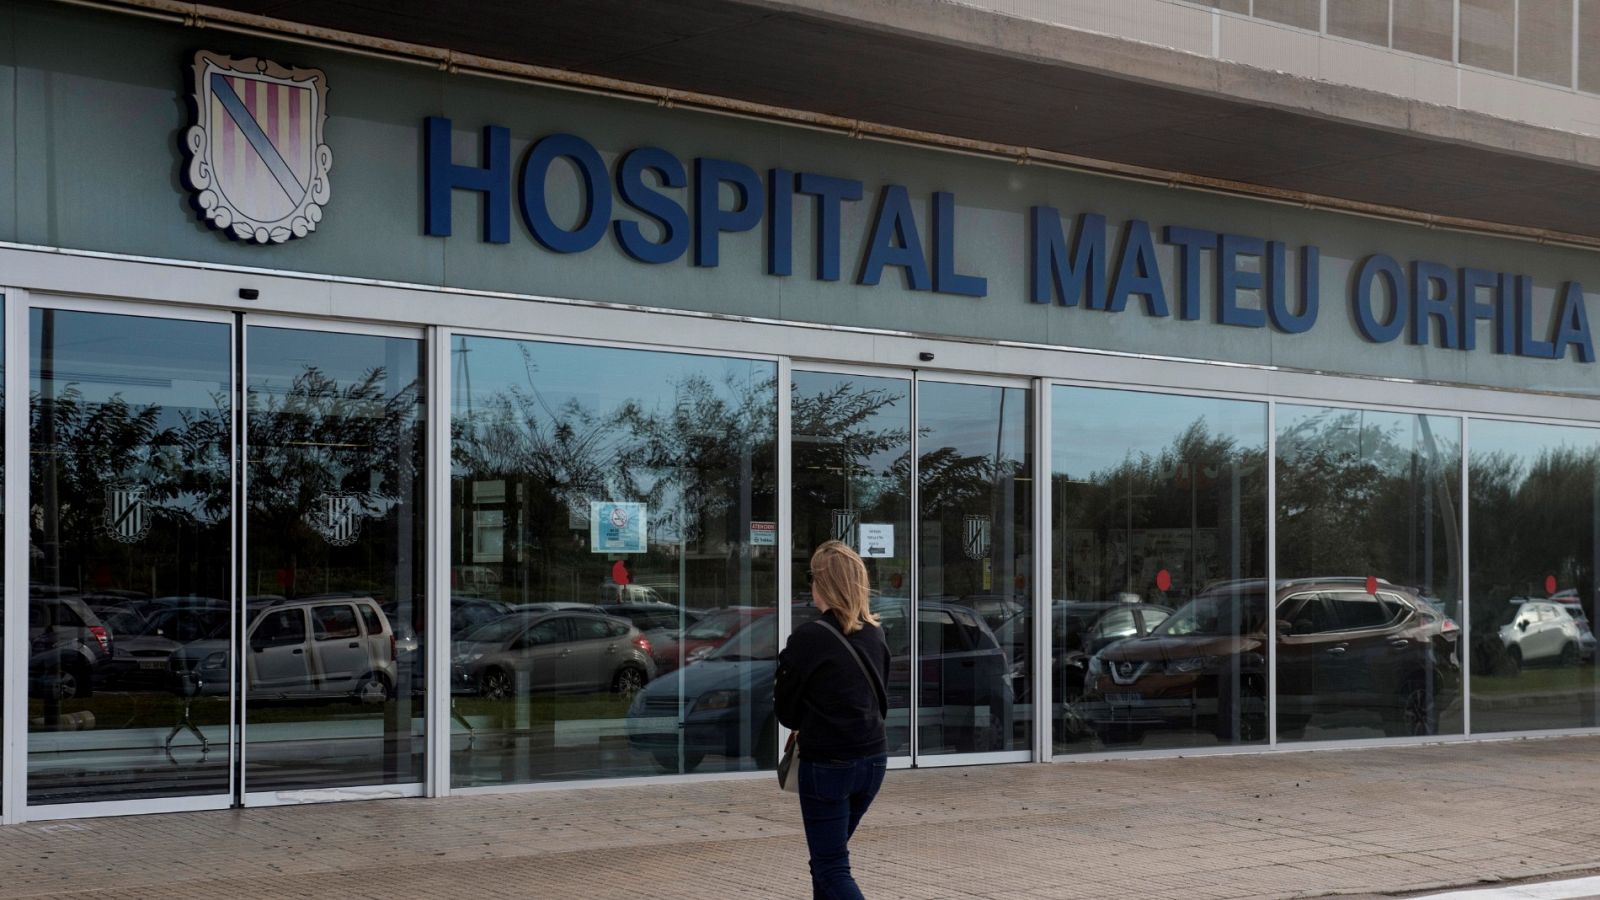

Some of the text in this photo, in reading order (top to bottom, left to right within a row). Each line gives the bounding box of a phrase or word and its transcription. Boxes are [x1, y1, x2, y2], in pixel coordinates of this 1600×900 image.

[424, 116, 1596, 363] HOSPITAL MATEU ORFILA
